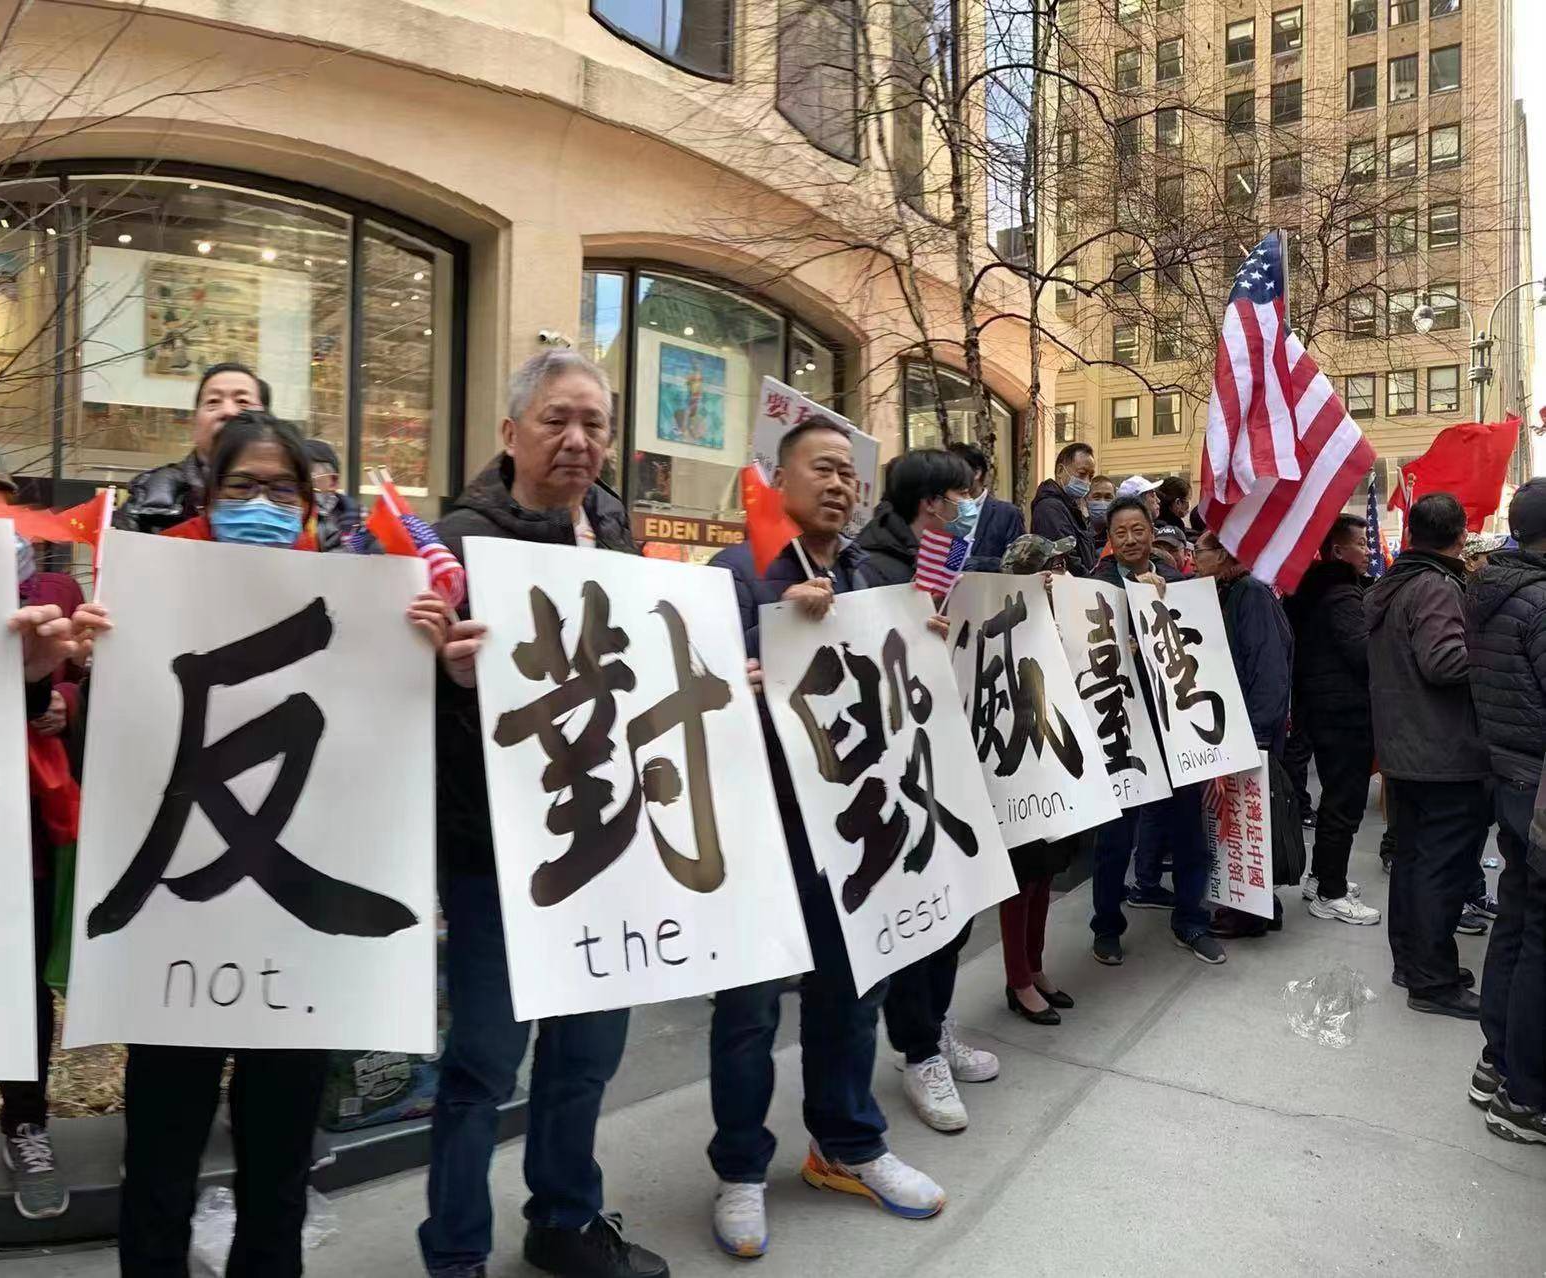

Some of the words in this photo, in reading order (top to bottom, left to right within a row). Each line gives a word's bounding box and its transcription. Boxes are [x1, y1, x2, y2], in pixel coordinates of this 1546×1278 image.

[645, 517, 700, 541] EDEN
[706, 523, 744, 544] Fine
[86, 597, 419, 939] 反
[493, 580, 734, 907] 對
[1211, 877, 1221, 899] Part
[575, 917, 718, 978] the.
[163, 958, 317, 1014] not.
